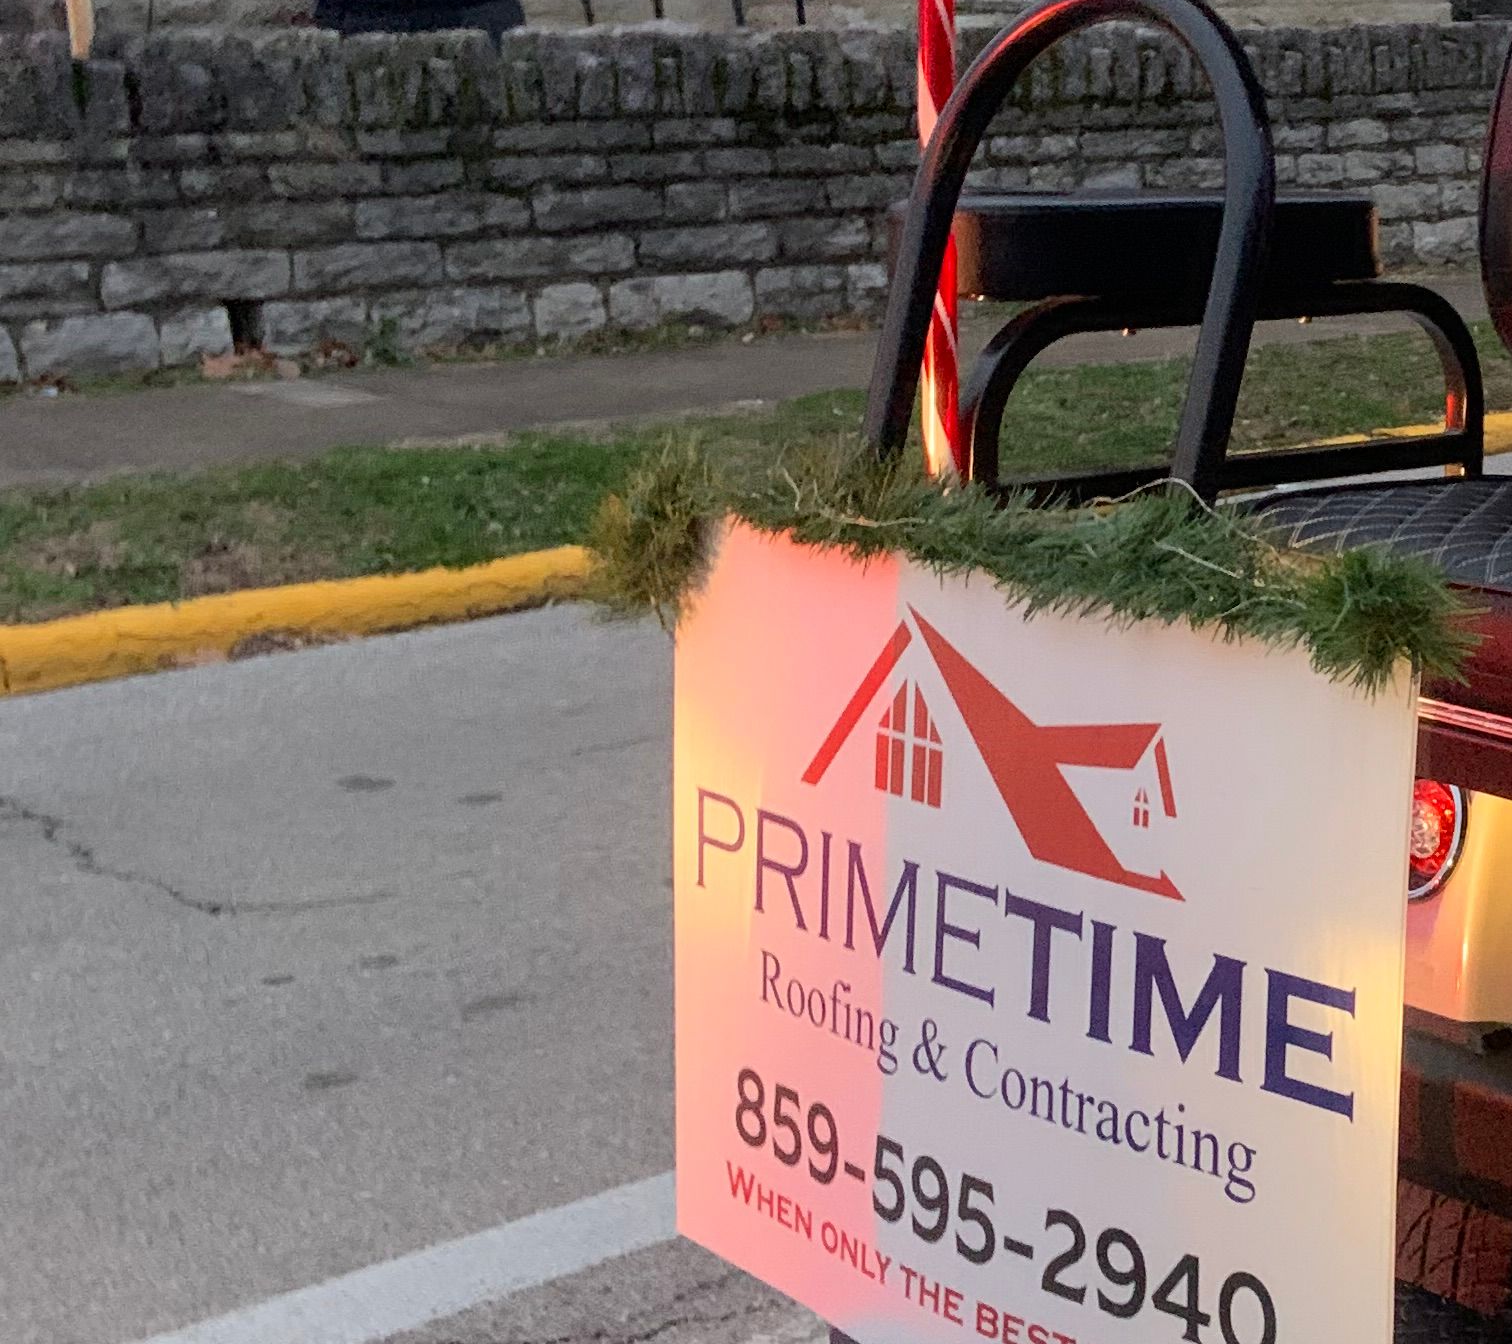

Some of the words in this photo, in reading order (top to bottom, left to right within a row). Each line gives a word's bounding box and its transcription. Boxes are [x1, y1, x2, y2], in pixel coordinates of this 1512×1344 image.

[695, 787, 1358, 1123] PRIMETIME
[759, 949, 900, 1076] Roofing
[911, 1018, 950, 1083] &
[963, 1038, 1258, 1205] Contracting
[725, 1159, 814, 1242] WHEN
[819, 1220, 893, 1286] ONLY
[900, 1264, 965, 1327] THE
